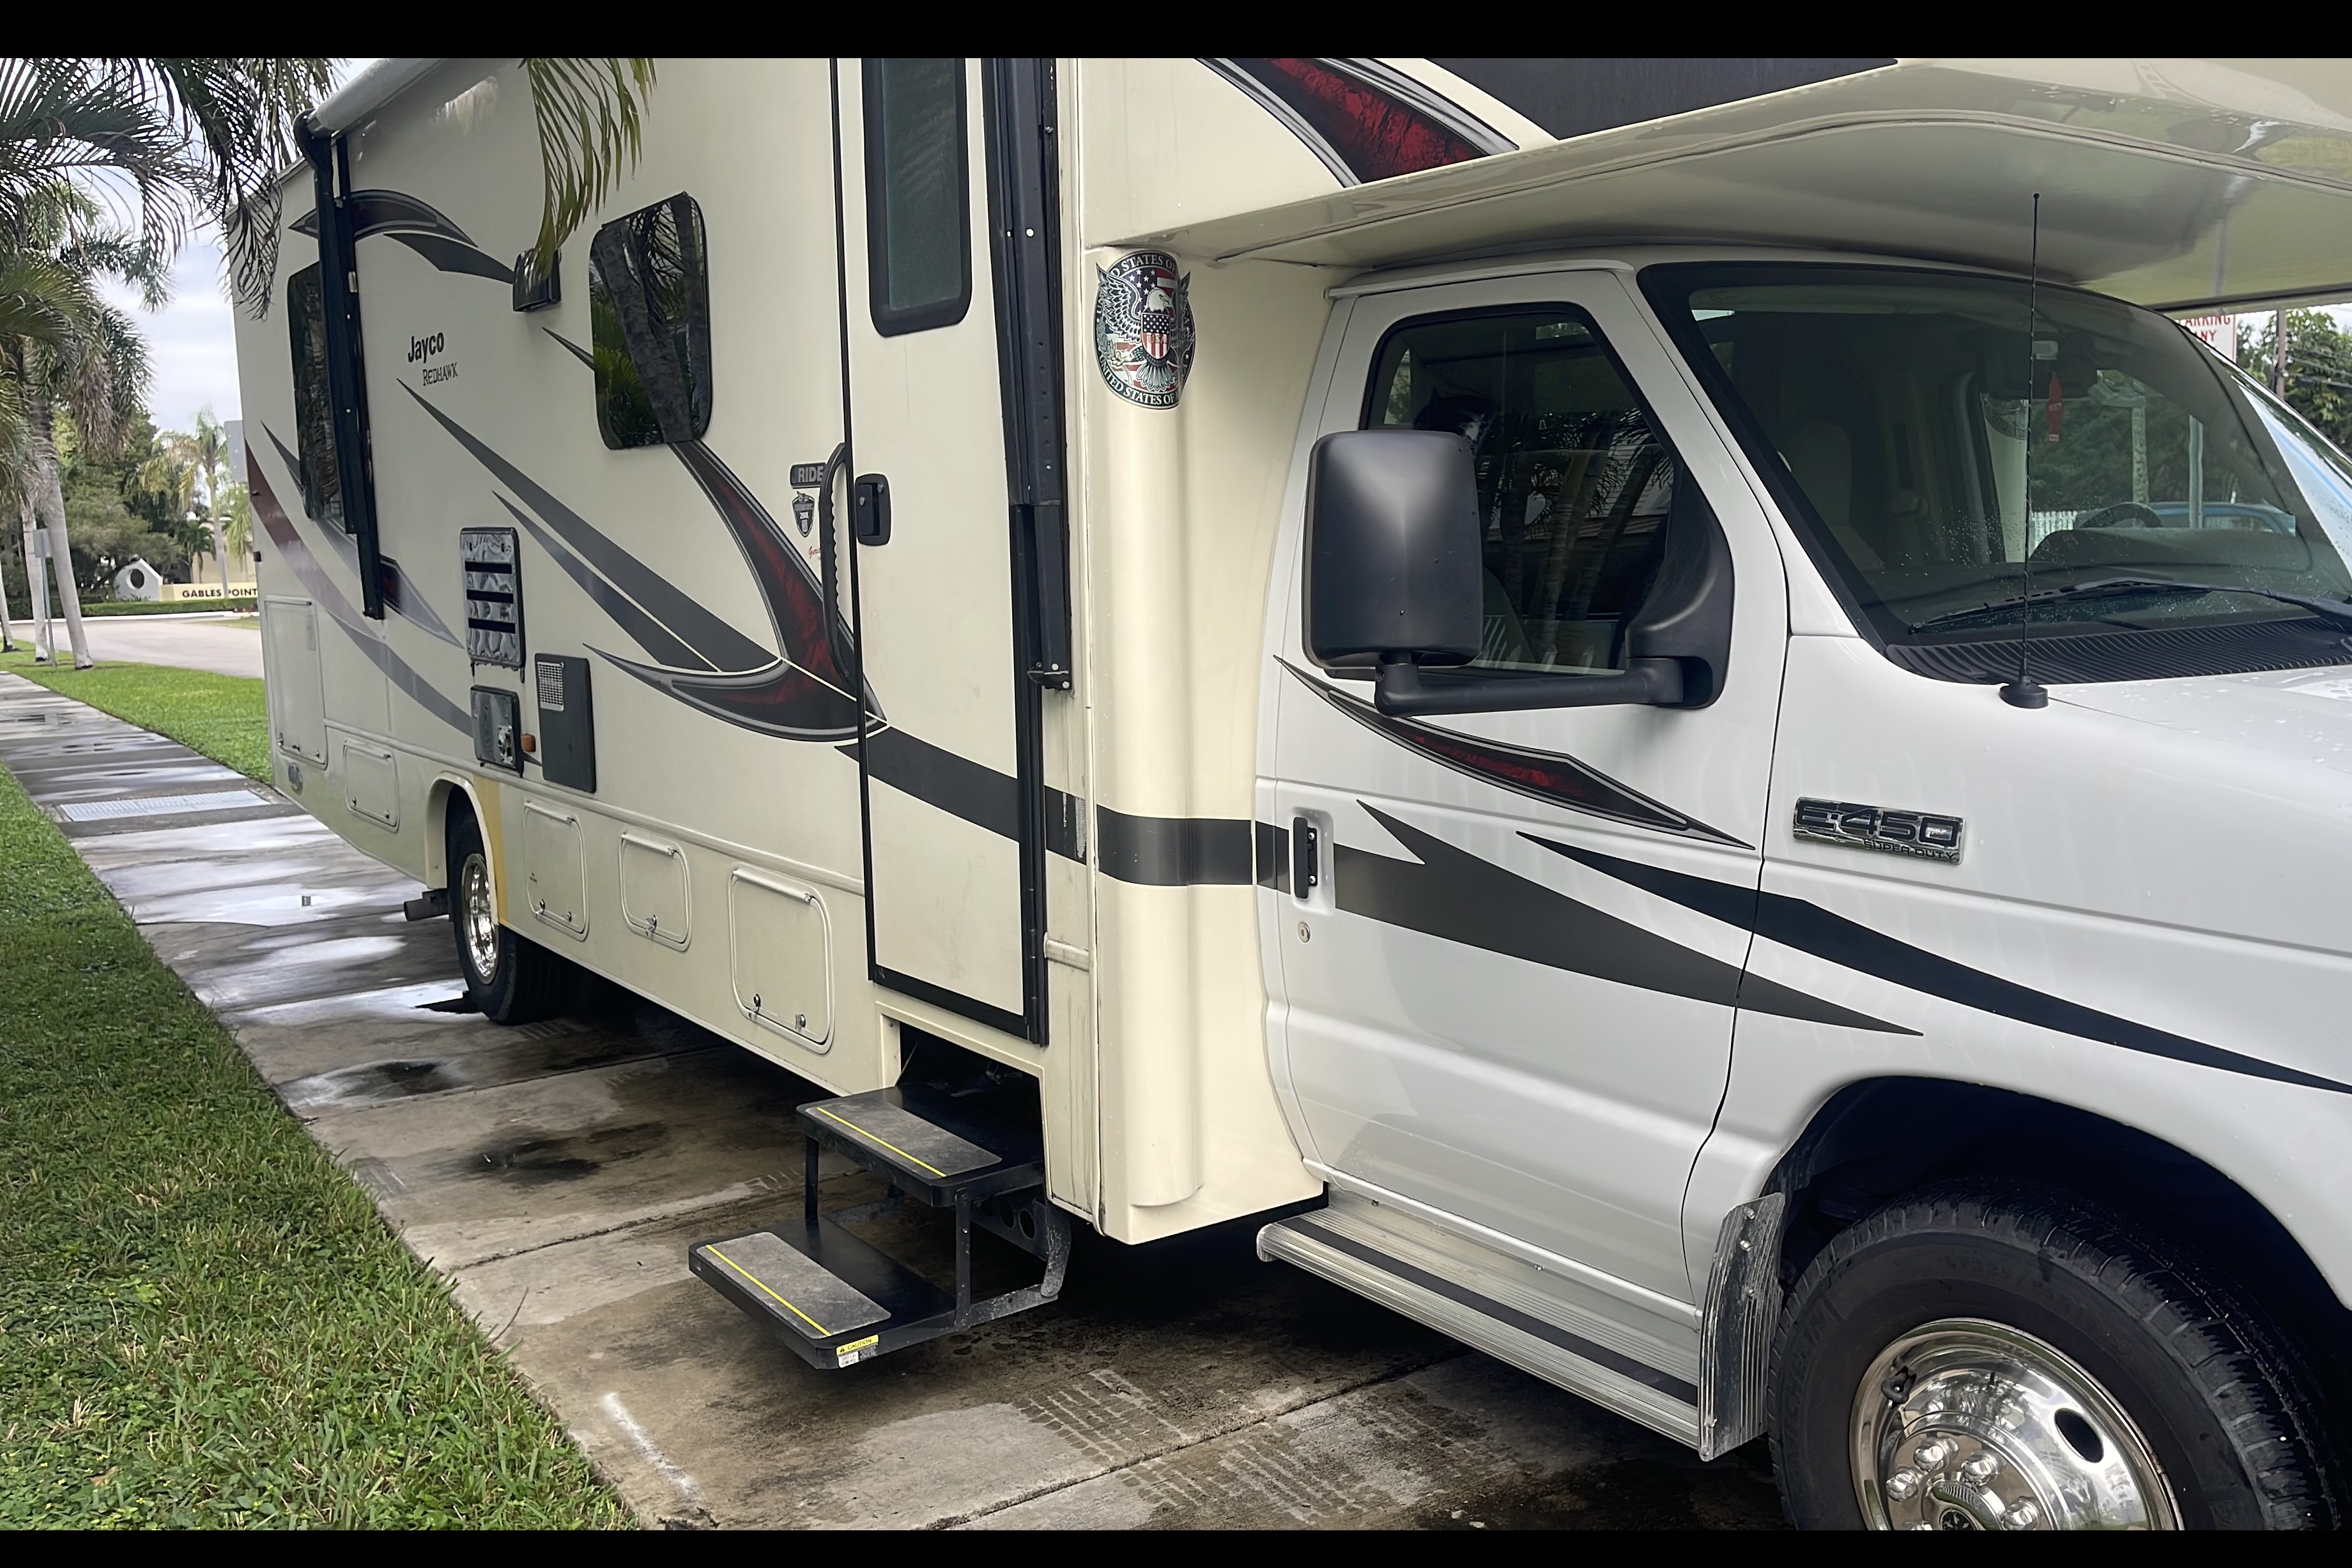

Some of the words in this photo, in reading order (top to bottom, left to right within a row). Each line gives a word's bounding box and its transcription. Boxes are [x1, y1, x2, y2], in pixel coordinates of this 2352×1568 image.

[1121, 254, 1163, 272] STATES
[2179, 316, 2230, 327] ARKING
[1146, 333, 1167, 343] USA
[408, 332, 444, 364] Jayco
[422, 362, 458, 387] REDHAWK
[1099, 355, 1124, 392] UNITED
[1123, 387, 1162, 405] STATES
[182, 589, 222, 597] GABLES
[1796, 800, 1960, 847] E-450
[1864, 840, 1910, 855] SUPER
[1916, 849, 1954, 860] DUTY
[847, 1338, 872, 1350] CAUTION
